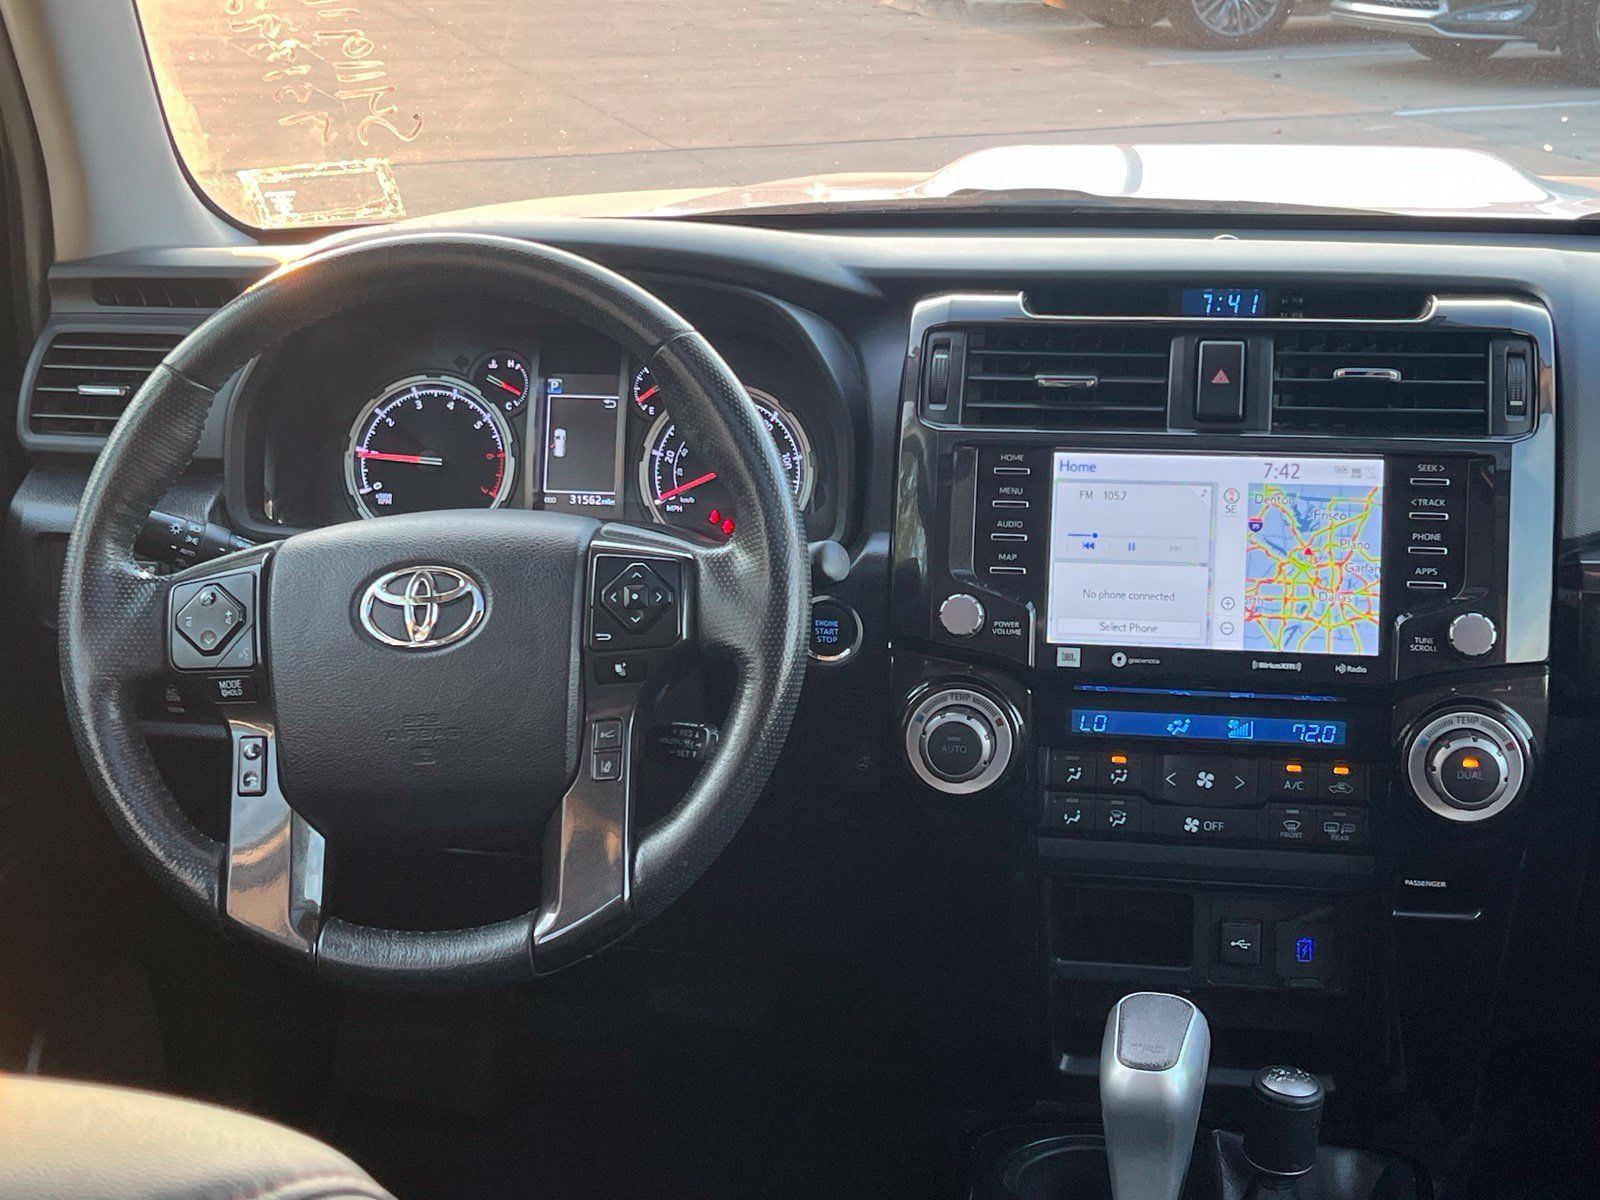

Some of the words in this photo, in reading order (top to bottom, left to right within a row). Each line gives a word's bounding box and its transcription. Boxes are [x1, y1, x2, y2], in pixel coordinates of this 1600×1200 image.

[1202, 294, 1259, 314] 7:41
[550, 380, 560, 392] P
[415, 399, 423, 410] 3
[446, 401, 455, 410] 4
[385, 417, 395, 427] 2
[473, 420, 483, 430] 5
[664, 449, 675, 464] 20
[1000, 454, 1024, 462] HOME
[1060, 460, 1097, 473] Home
[1264, 463, 1301, 481] 7:42
[998, 487, 1024, 495] MENU
[1079, 490, 1094, 500] FM
[1104, 491, 1128, 502] 105.7
[569, 495, 602, 505] 31562
[665, 504, 683, 512] MPH
[1225, 503, 1238, 515] SE
[1313, 509, 1348, 521] Frisco
[996, 520, 1024, 529] AUDIO
[1412, 533, 1442, 541] PHONE
[1340, 538, 1371, 551] Plano
[998, 553, 1018, 561] MAP
[1414, 567, 1438, 576] APPS
[1082, 590, 1097, 600] No
[1099, 590, 1126, 601] phone
[1128, 592, 1178, 602] connected.
[1318, 591, 1353, 603] Dallas
[815, 619, 839, 627] ENGINE
[993, 620, 1020, 629] POWER
[1099, 622, 1128, 632] Select
[1129, 623, 1159, 634] Phone
[815, 627, 839, 636] START
[992, 628, 1022, 637] VOLUME
[1414, 637, 1435, 645] TUNE
[1410, 644, 1438, 653] SCROLL
[1347, 665, 1368, 673] Radio
[218, 680, 243, 690] MODE
[949, 692, 971, 702] TEMP
[1455, 715, 1479, 726] TEMP
[943, 744, 968, 754] AUTO
[1457, 770, 1484, 780] DUAL
[1283, 781, 1305, 792] A/C
[1203, 821, 1225, 832] OFF
[1404, 879, 1448, 888] PASSENGER
